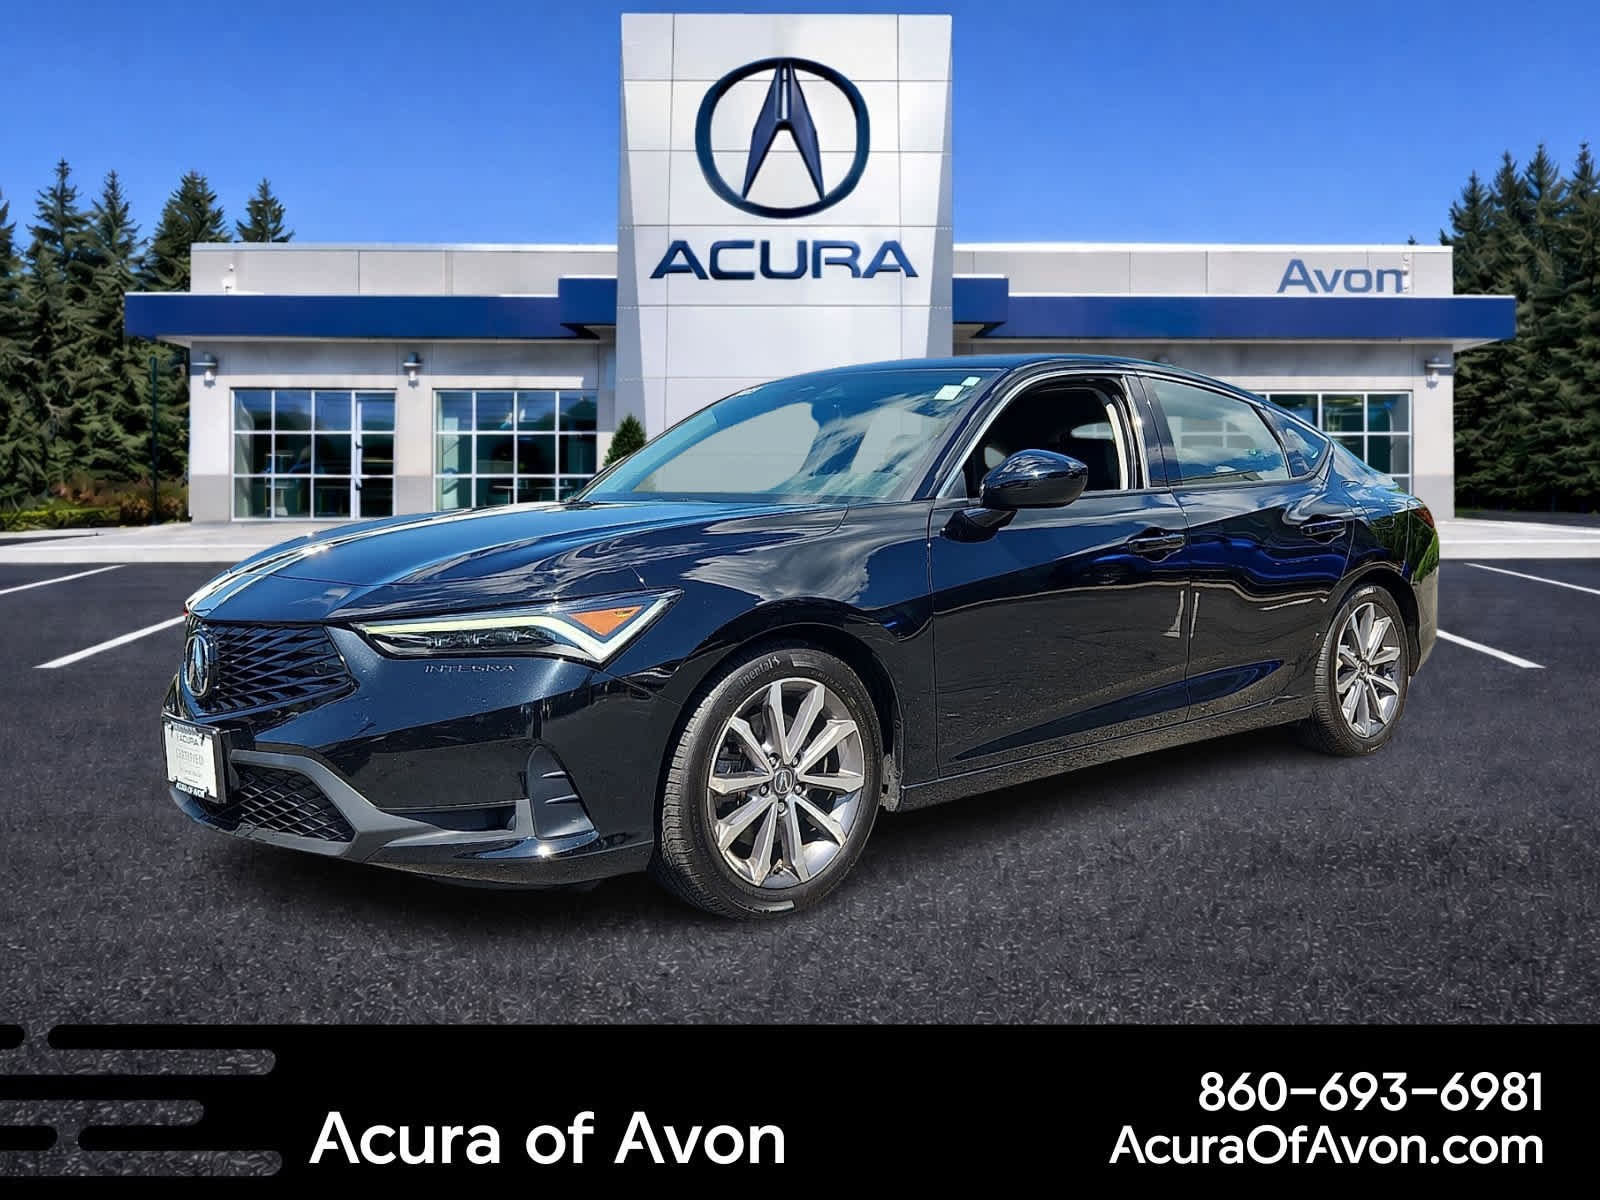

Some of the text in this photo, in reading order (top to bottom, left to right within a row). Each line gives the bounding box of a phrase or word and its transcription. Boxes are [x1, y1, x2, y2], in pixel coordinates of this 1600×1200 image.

[650, 240, 919, 281] ACURA
[1277, 258, 1404, 294] Avon
[424, 664, 516, 673] INTEGRA
